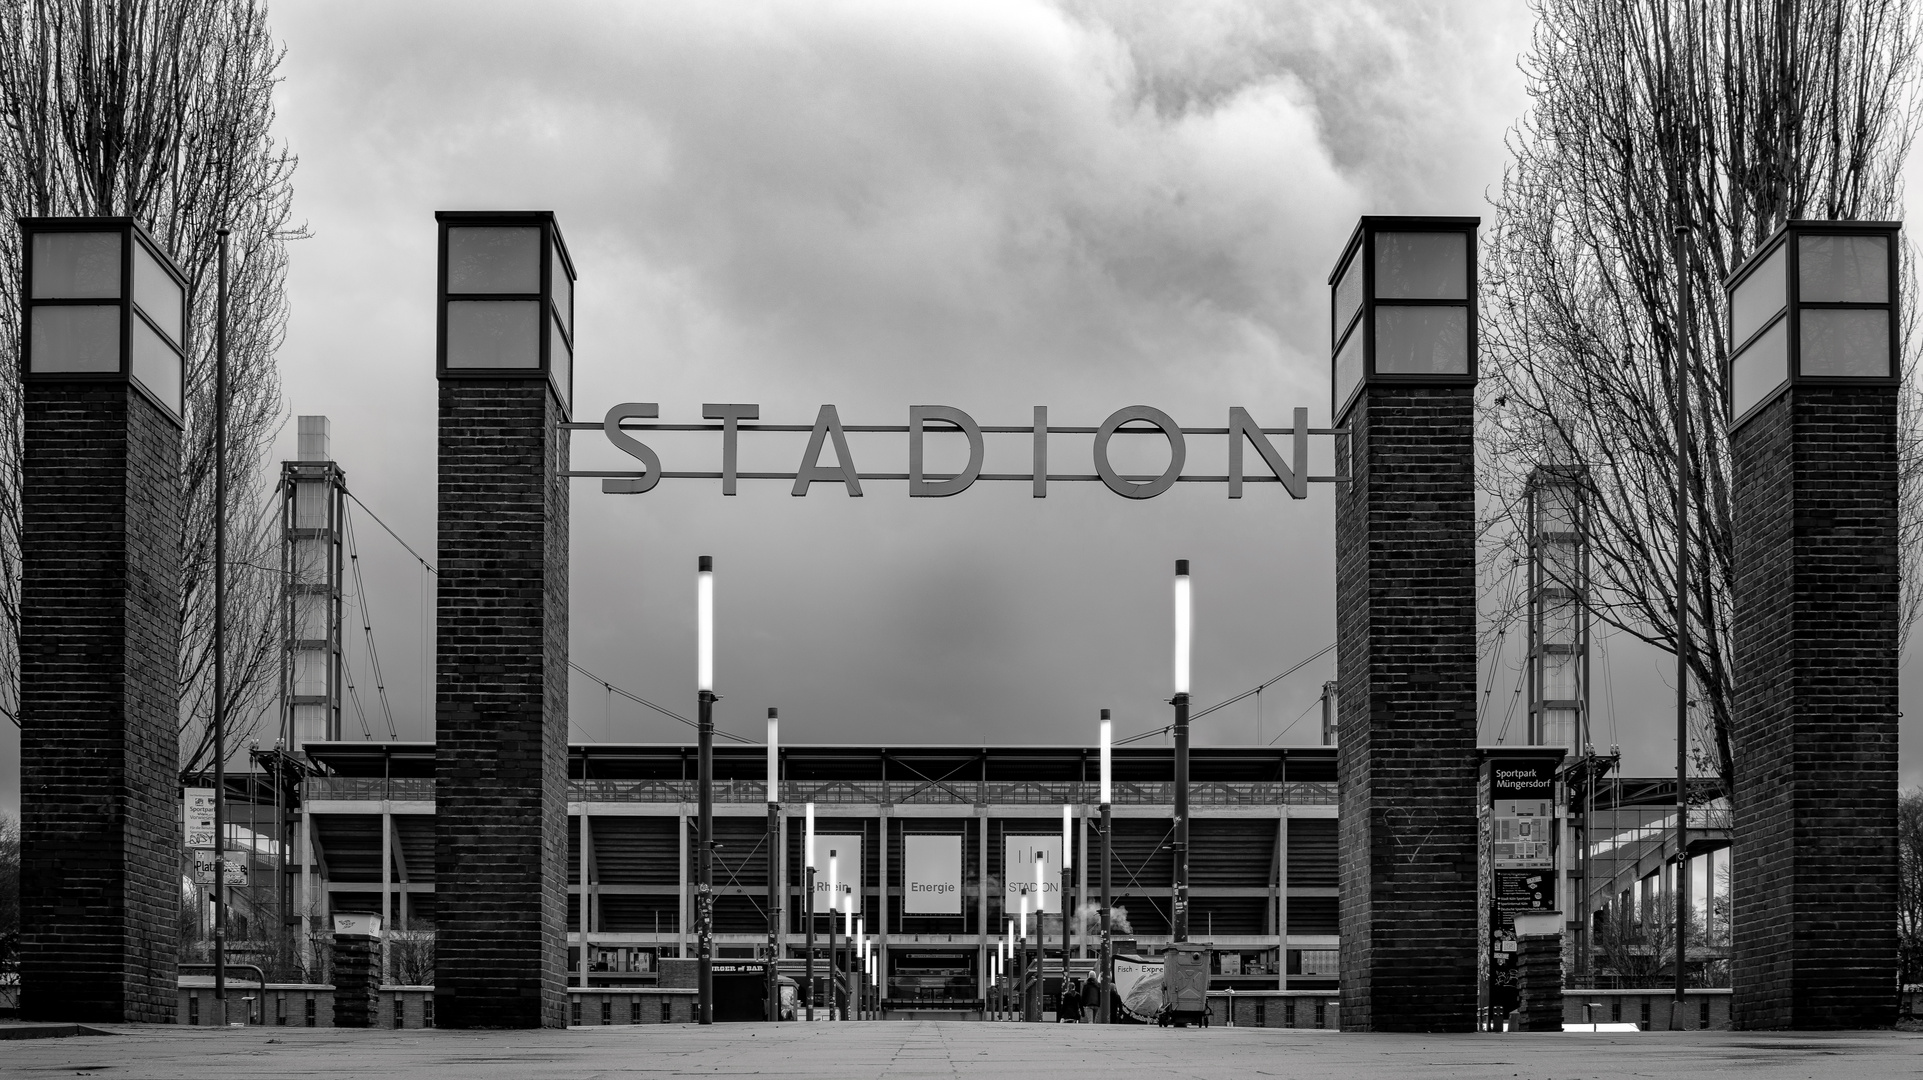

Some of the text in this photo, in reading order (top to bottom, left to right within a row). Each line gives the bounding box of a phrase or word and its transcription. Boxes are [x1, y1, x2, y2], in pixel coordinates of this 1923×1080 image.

[602, 402, 1308, 500] STADION
[1496, 769, 1537, 779] Sportpark
[1496, 779, 1551, 790] Müngersdorf
[911, 882, 955, 894] Energie
[1008, 882, 1058, 892] STADON
[1117, 965, 1133, 973] Fisch
[1141, 965, 1164, 974] Expre
